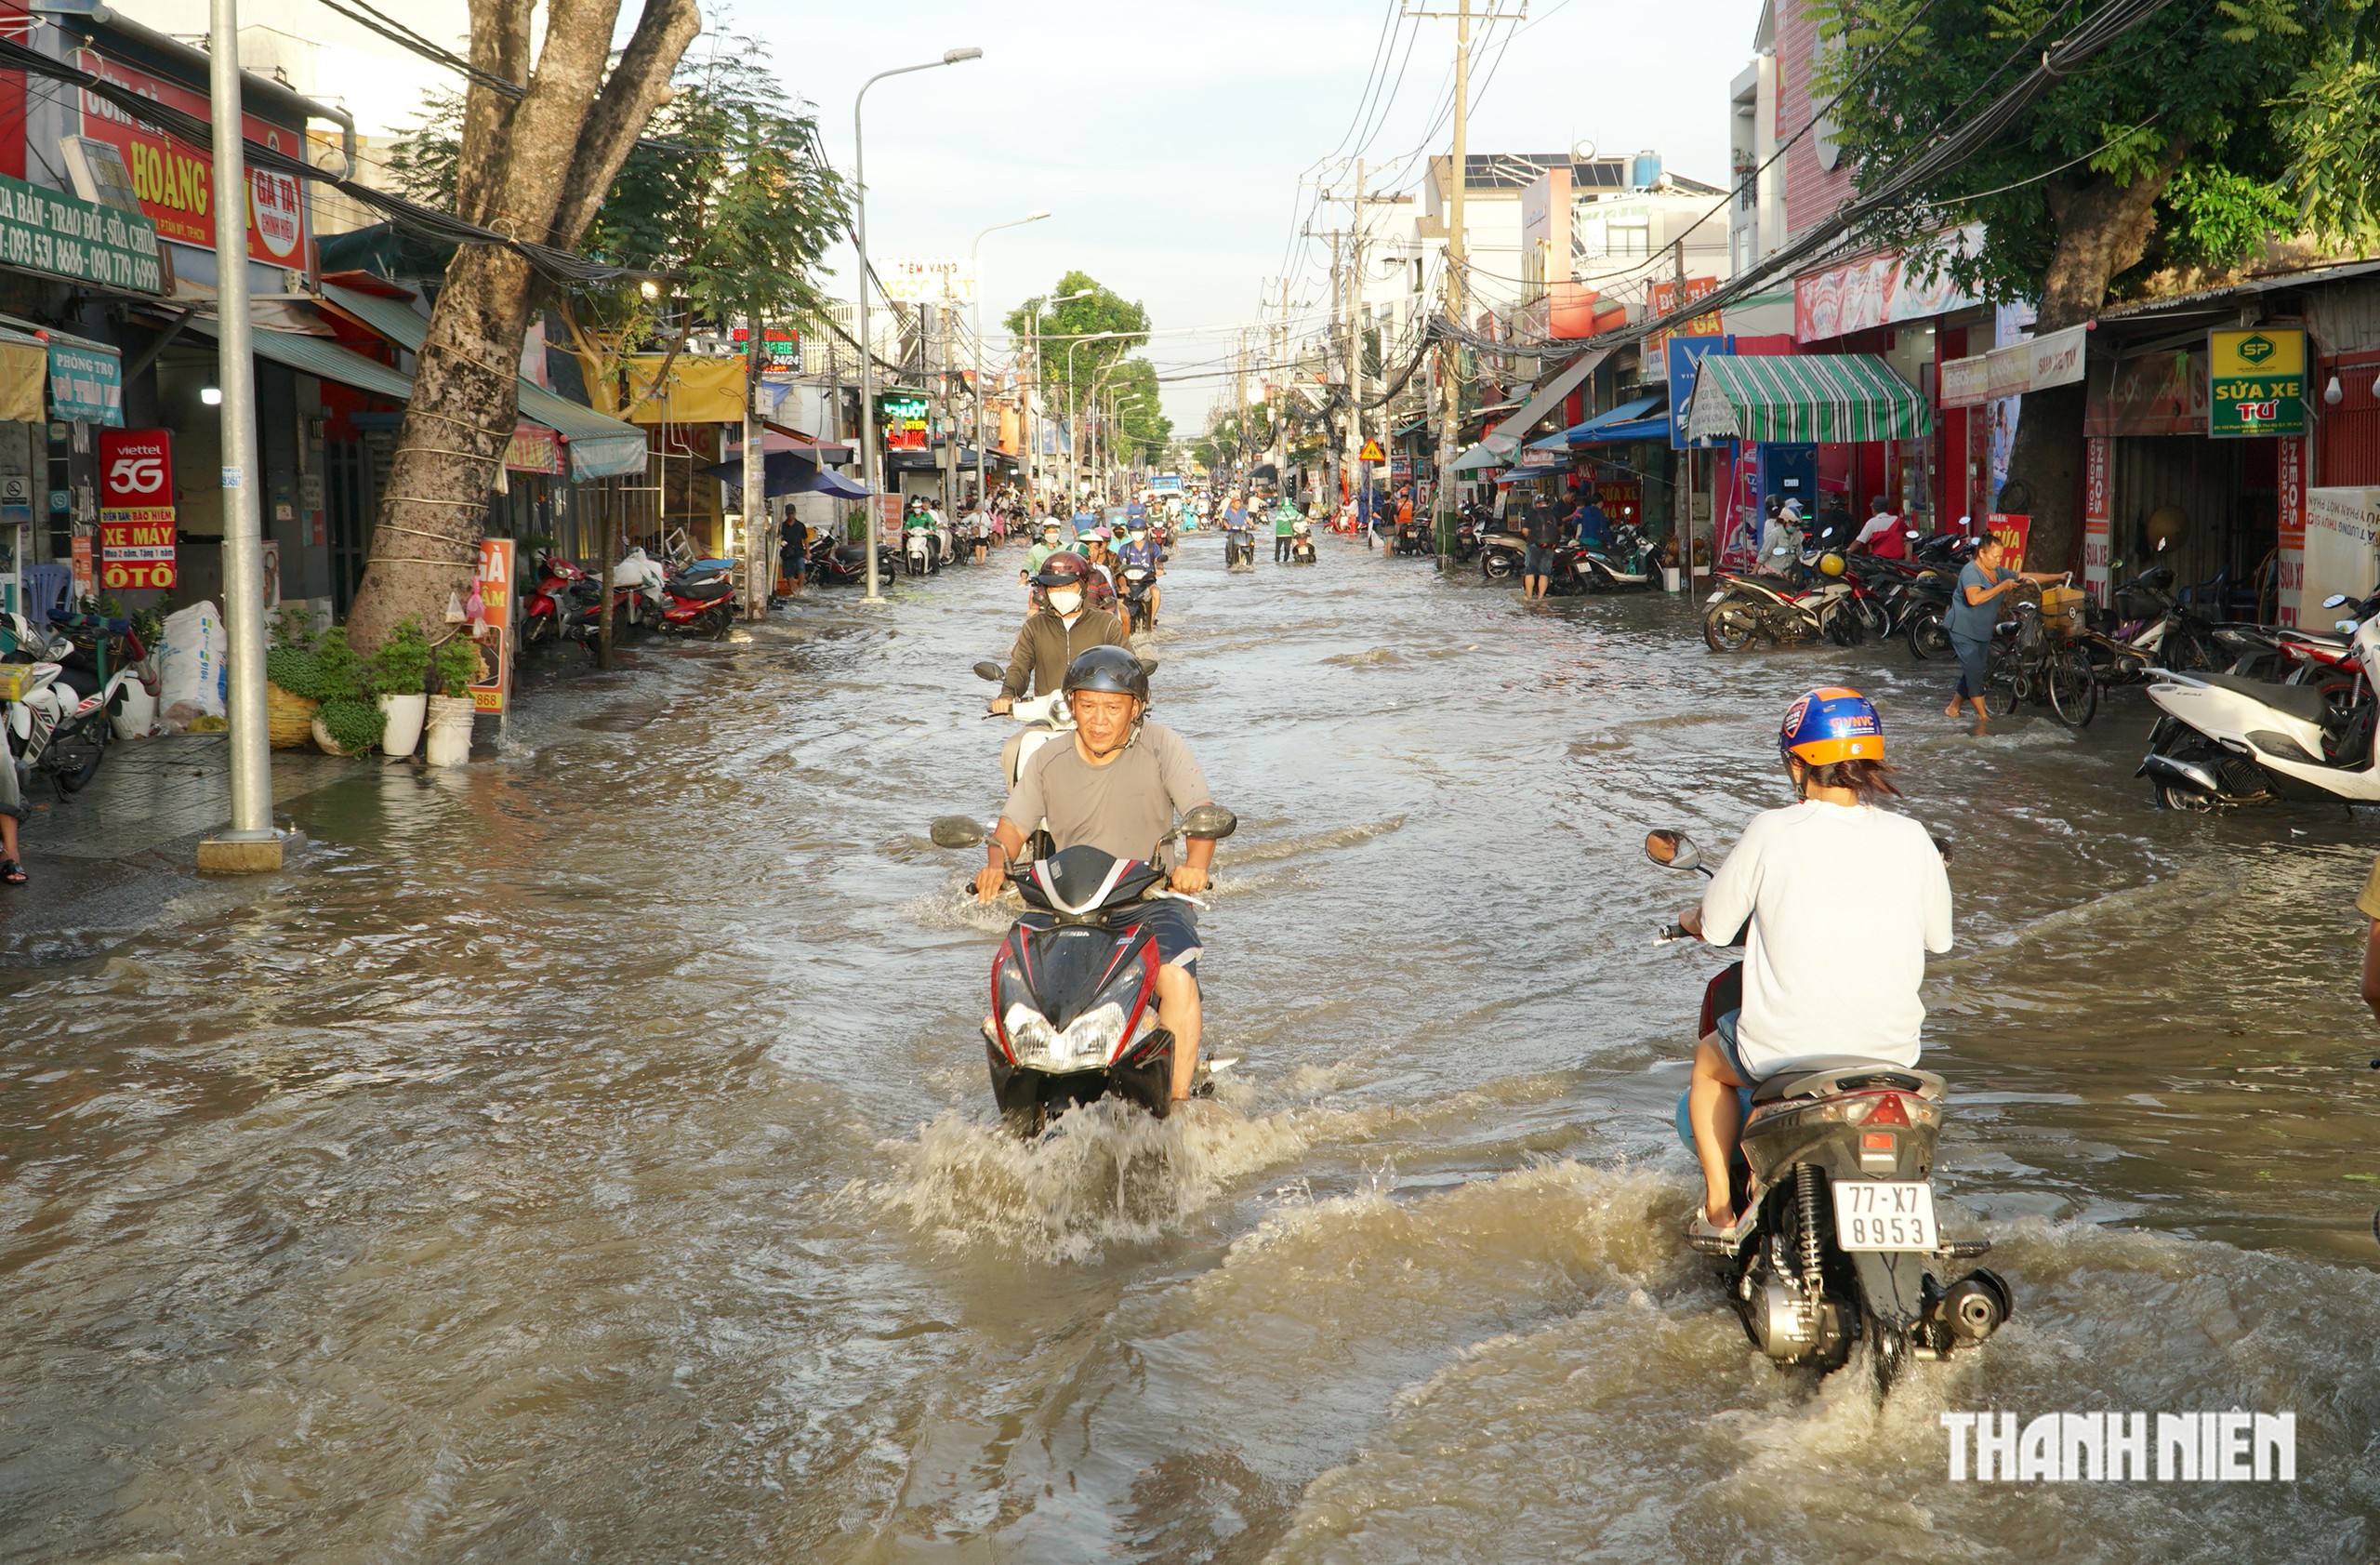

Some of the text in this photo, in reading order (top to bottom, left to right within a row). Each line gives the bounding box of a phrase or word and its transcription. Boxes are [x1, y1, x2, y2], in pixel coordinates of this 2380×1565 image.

[130, 136, 207, 216] HOÀNG
[279, 178, 297, 215] TA
[17, 185, 45, 227] BÁN
[49, 202, 81, 237] TRAO
[83, 204, 103, 243] ĐỔI
[129, 222, 159, 257] CHỮA
[9, 226, 33, 264] 093
[34, 234, 53, 269] 531
[57, 238, 84, 276] 8686
[90, 246, 112, 282] 090
[112, 253, 132, 285] 779
[135, 258, 160, 291] 6999
[773, 355, 800, 365] 24/24
[2243, 344, 2269, 355] SP
[57, 352, 114, 378] PHÒNG TRỌ
[2215, 380, 2300, 400] SỬA XE
[2236, 399, 2280, 421] TƯ
[117, 445, 163, 456] viettel
[889, 431, 926, 448] 50K
[110, 458, 164, 494] 5G
[2289, 435, 2298, 526] NEOS
[1989, 513, 2008, 524] NHẬN:
[104, 527, 126, 546] XE
[133, 523, 173, 546] MÁY
[118, 549, 123, 558] 2
[105, 562, 174, 588] ÔTÔ
[476, 694, 496, 707] 868
[1843, 715, 1874, 728] VNVC
[1852, 1218, 1924, 1244] 8953
